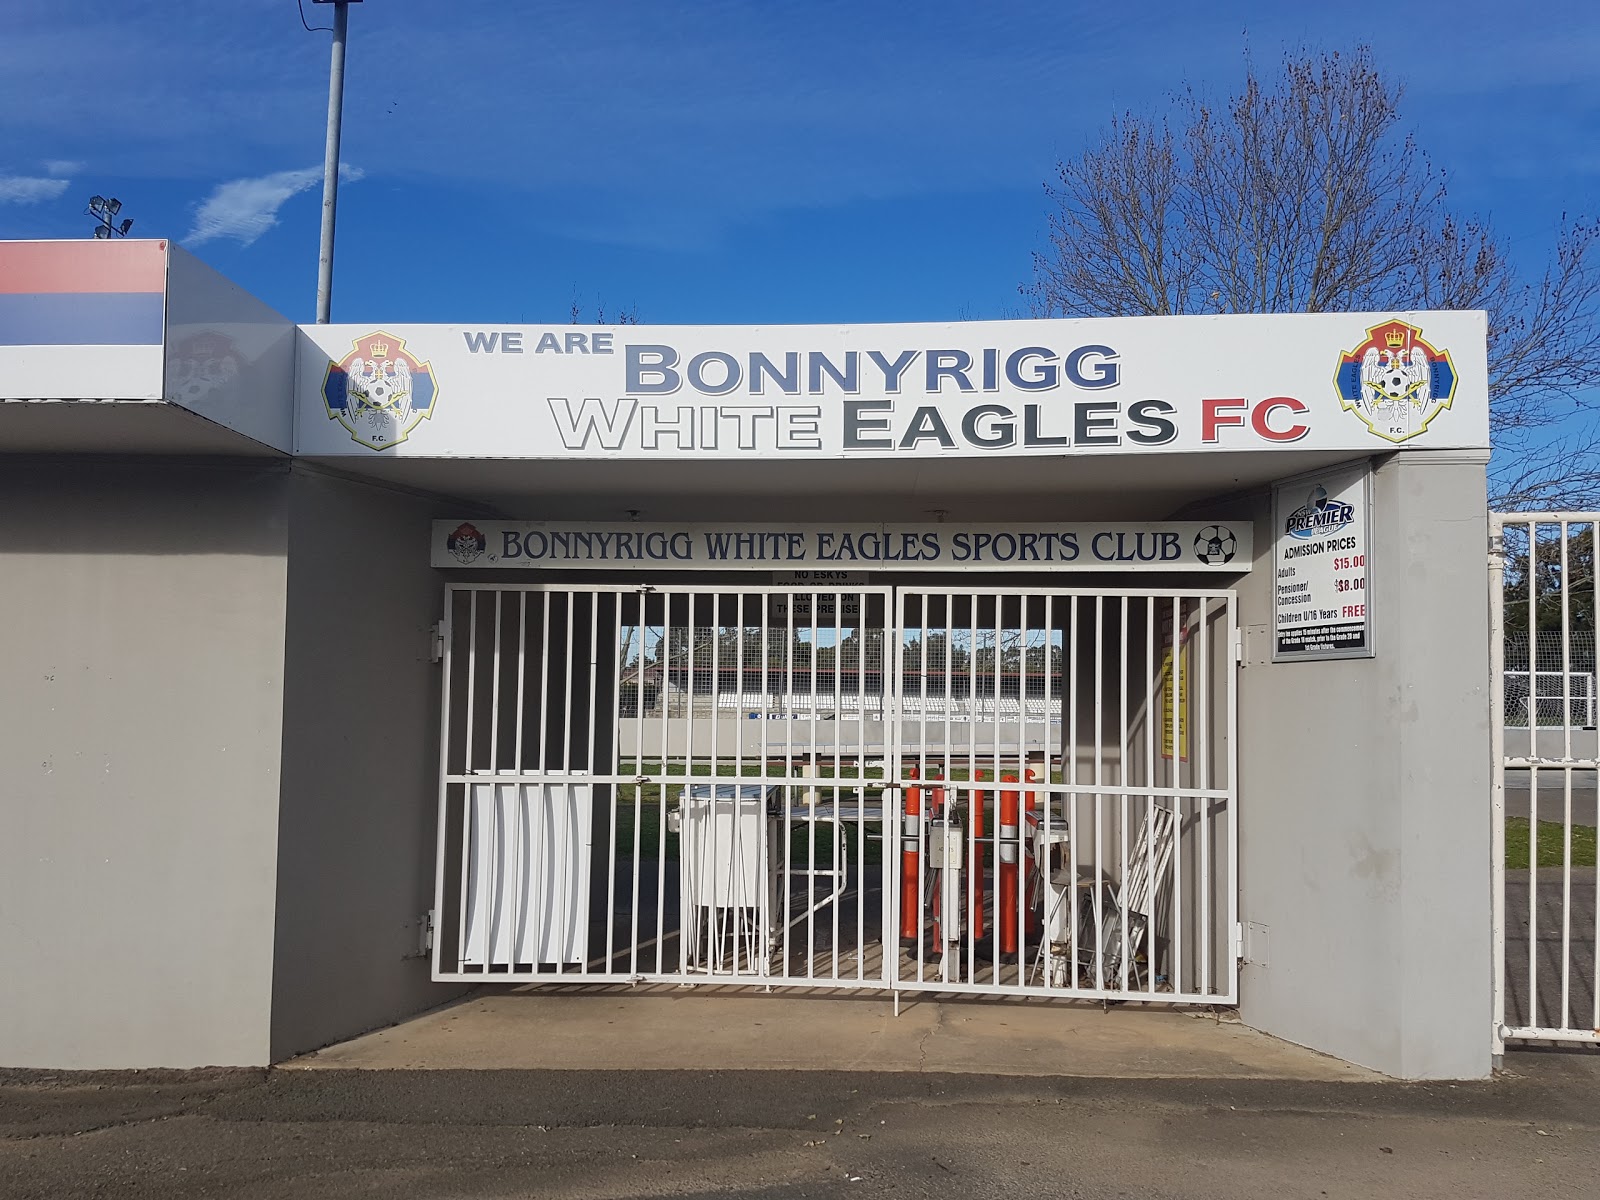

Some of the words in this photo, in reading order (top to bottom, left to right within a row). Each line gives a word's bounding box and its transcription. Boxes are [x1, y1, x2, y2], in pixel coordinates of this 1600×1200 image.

[463, 331, 523, 354] WE
[535, 332, 614, 354] ARE
[625, 344, 1120, 395] BONNYRIGG
[547, 398, 822, 450] WHITE
[843, 399, 1178, 451] EAGLES
[1201, 397, 1311, 443] FC
[1285, 504, 1354, 535] PREMIER
[501, 531, 693, 559] BONNYRIGG
[704, 532, 806, 560] WHITE
[816, 532, 941, 561] EAGLES
[951, 532, 1080, 561] SPORTS
[1091, 532, 1182, 561] CLUB
[1284, 541, 1325, 560] ADMISSION
[1326, 536, 1356, 552] PRICES
[1334, 555, 1365, 571] $15.00
[794, 571, 809, 579] NO
[813, 571, 848, 579] ESKYS
[1278, 567, 1296, 578] Adults
[1278, 580, 1309, 595] Pensioner/
[1278, 593, 1312, 606] Concession
[1278, 612, 1302, 624] Children
[1303, 610, 1318, 621] U/16
[1319, 609, 1338, 619] Years
[1342, 604, 1365, 618] FREE
